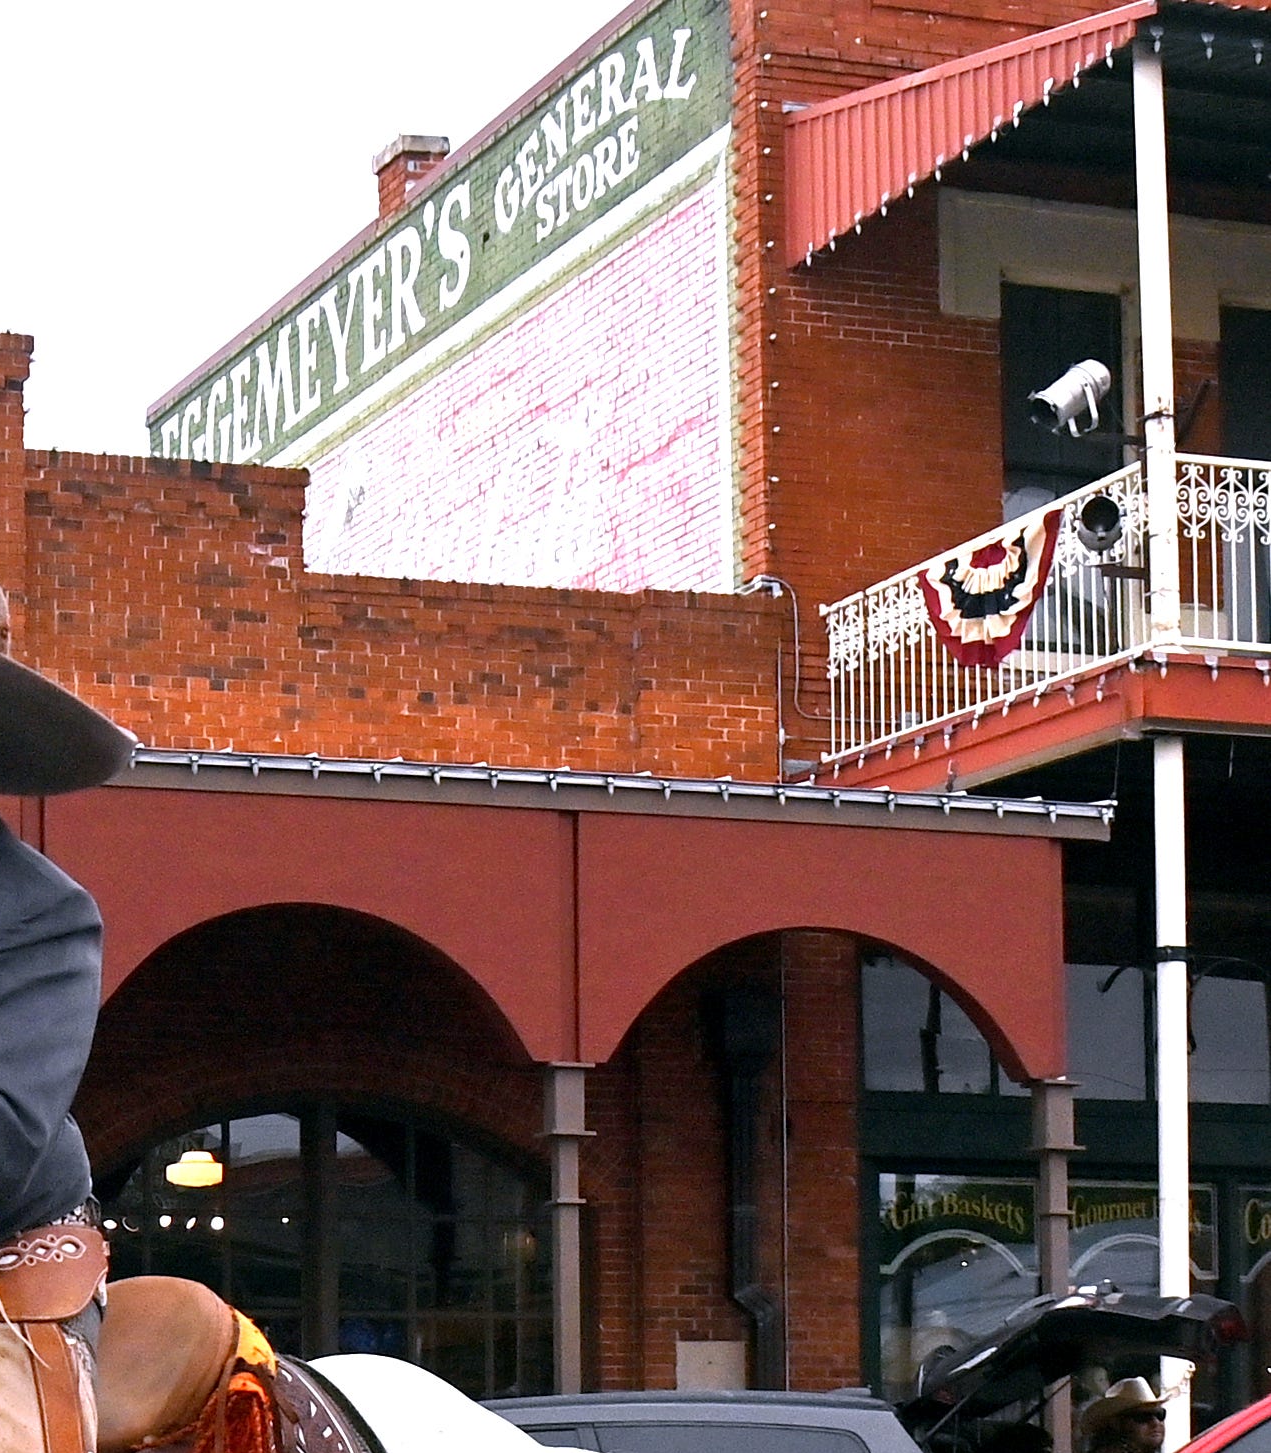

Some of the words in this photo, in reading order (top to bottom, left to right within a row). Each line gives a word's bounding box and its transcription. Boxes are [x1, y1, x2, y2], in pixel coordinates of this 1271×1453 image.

[494, 28, 697, 233] GENERAL
[536, 115, 640, 243] STORE
[942, 1191, 1025, 1235] Baskets
[1071, 1195, 1149, 1233] Gourmet
